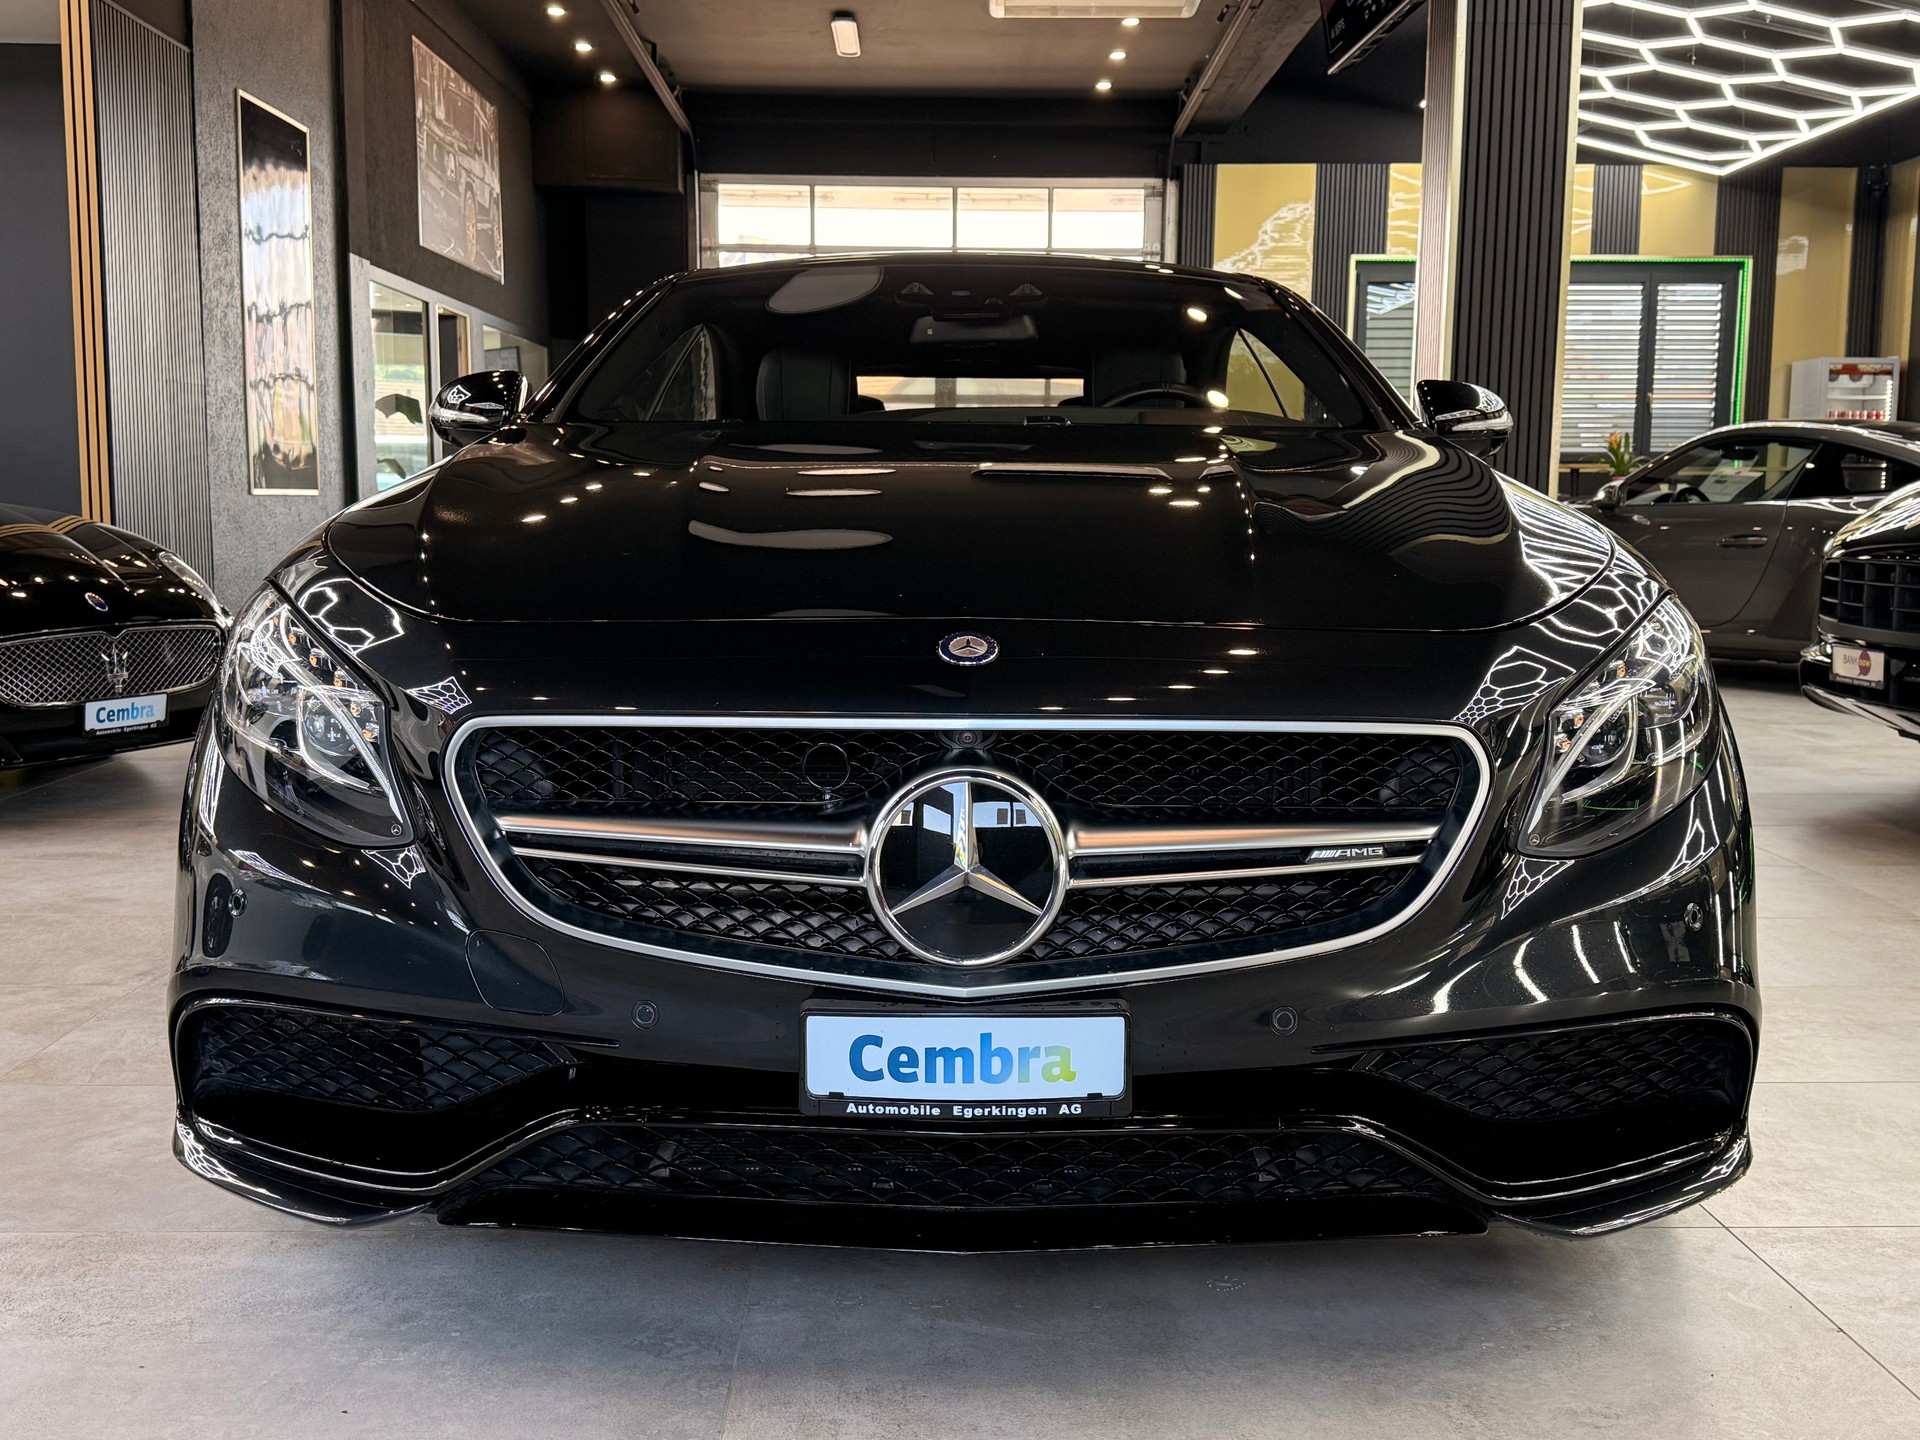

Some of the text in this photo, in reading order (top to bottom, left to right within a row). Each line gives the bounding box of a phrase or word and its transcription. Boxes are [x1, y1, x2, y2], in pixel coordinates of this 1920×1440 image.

[1843, 654, 1858, 665] BANK
[96, 702, 154, 723] Cembra
[1335, 847, 1384, 857] AMG
[849, 1032, 1077, 1084] Cembra
[846, 1102, 1082, 1119] Automobile Egerkingen AG
